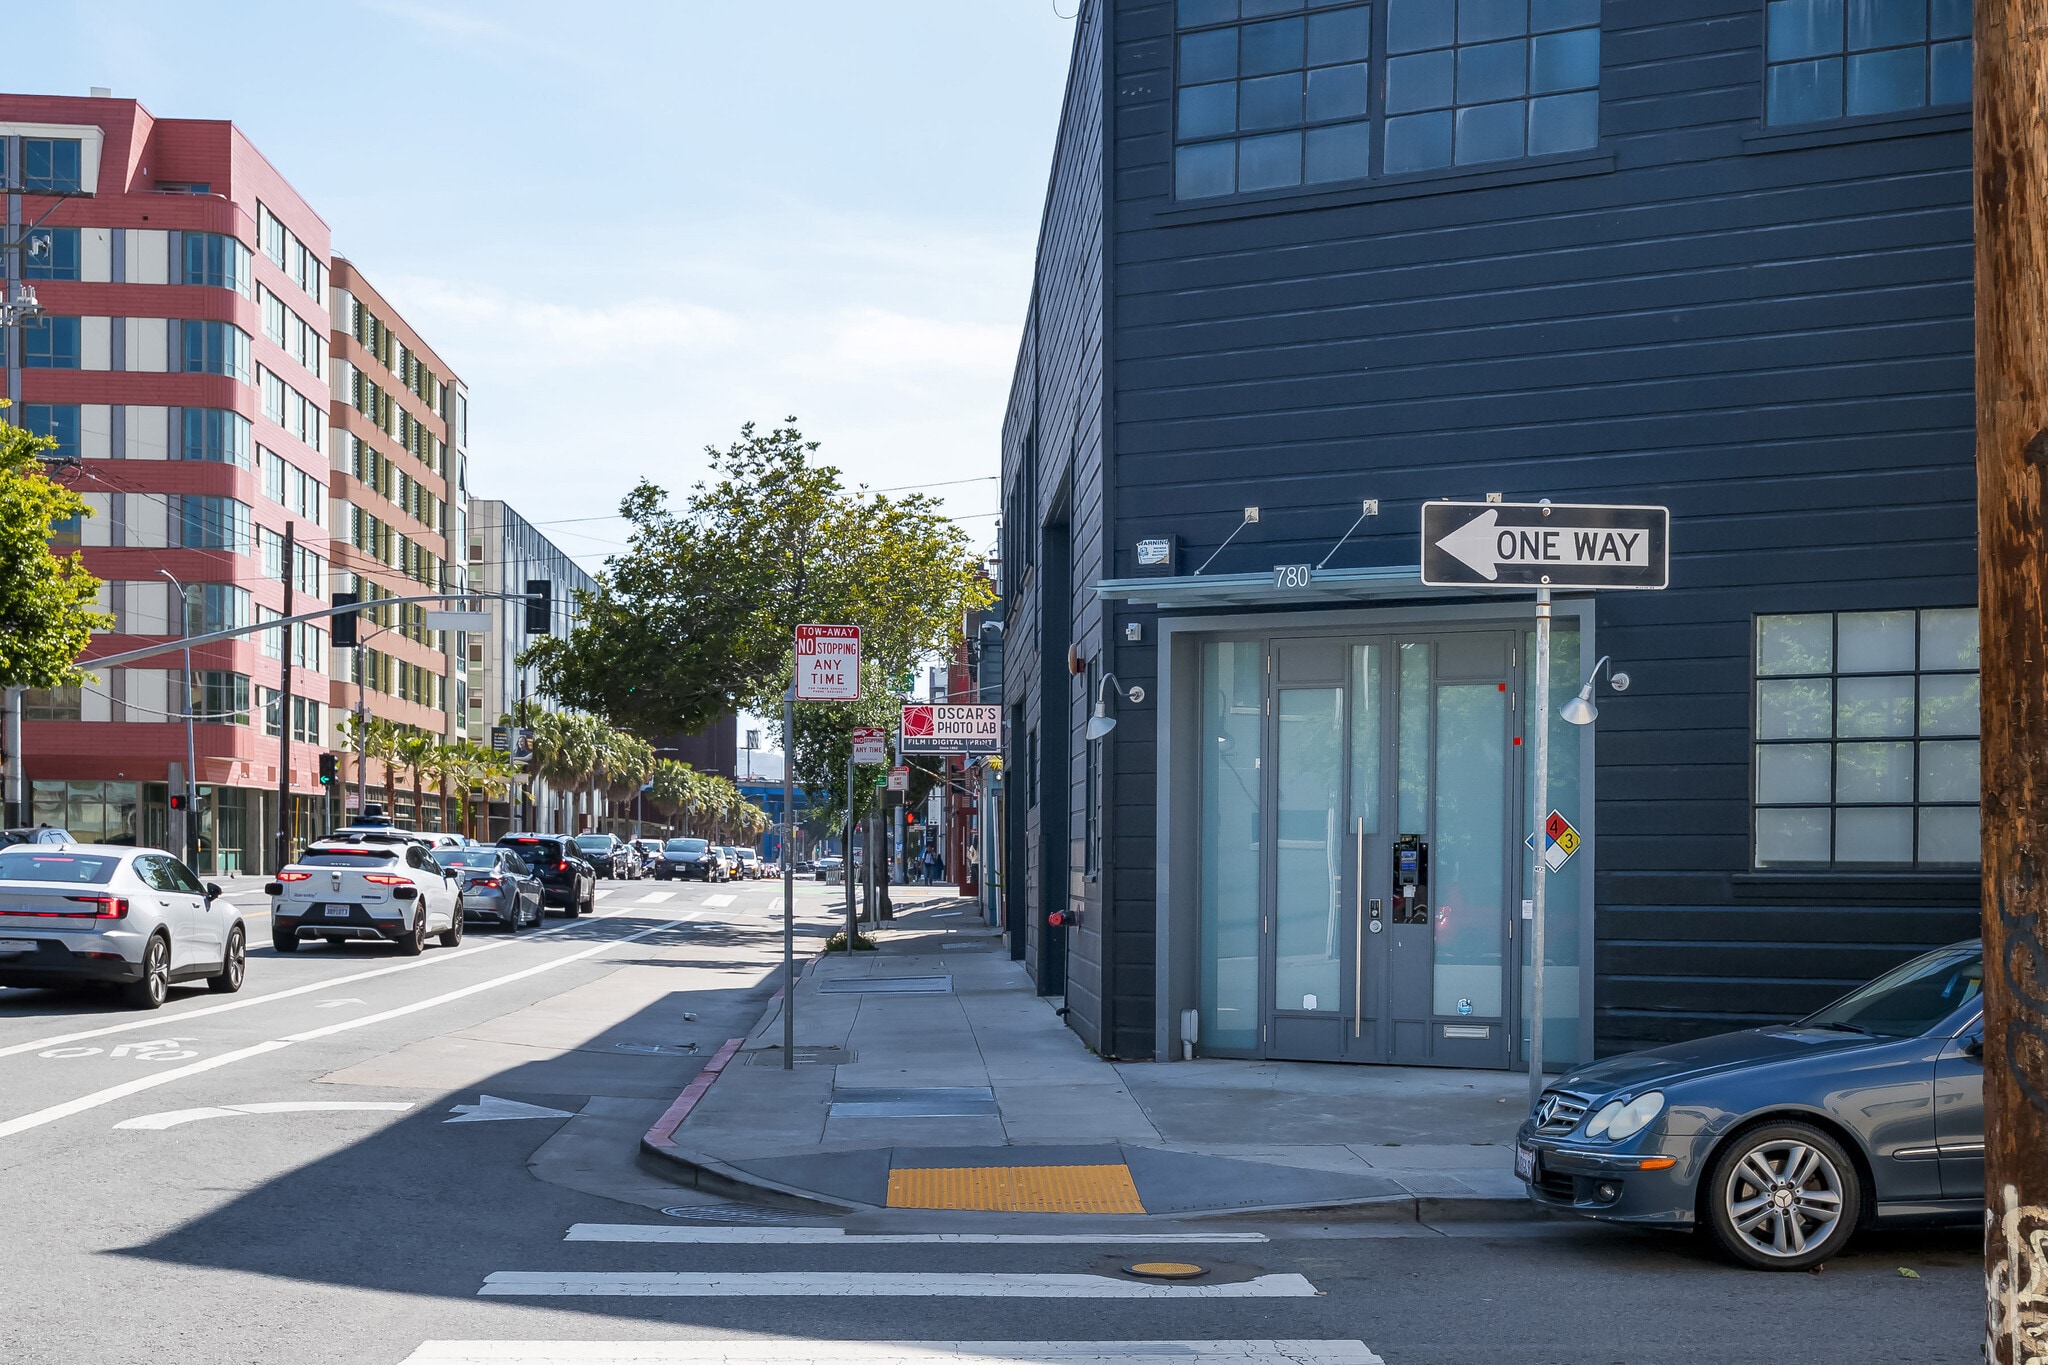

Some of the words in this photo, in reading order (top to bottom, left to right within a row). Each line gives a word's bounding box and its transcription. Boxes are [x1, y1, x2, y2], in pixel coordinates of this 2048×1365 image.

[1497, 530, 1561, 560] ONE
[1574, 532, 1640, 562] WAY
[1276, 566, 1308, 588] 780
[802, 627, 854, 637] TOW-AWAY
[798, 638, 814, 654] NO
[817, 642, 857, 655] STOPPING
[814, 659, 842, 670] ANY
[811, 673, 845, 685] TIME
[937, 707, 996, 720] OSCAR'S
[937, 721, 973, 734] PHOTO
[976, 721, 997, 734] LAB
[1550, 819, 1558, 834] 4
[1565, 833, 1574, 849] 3
